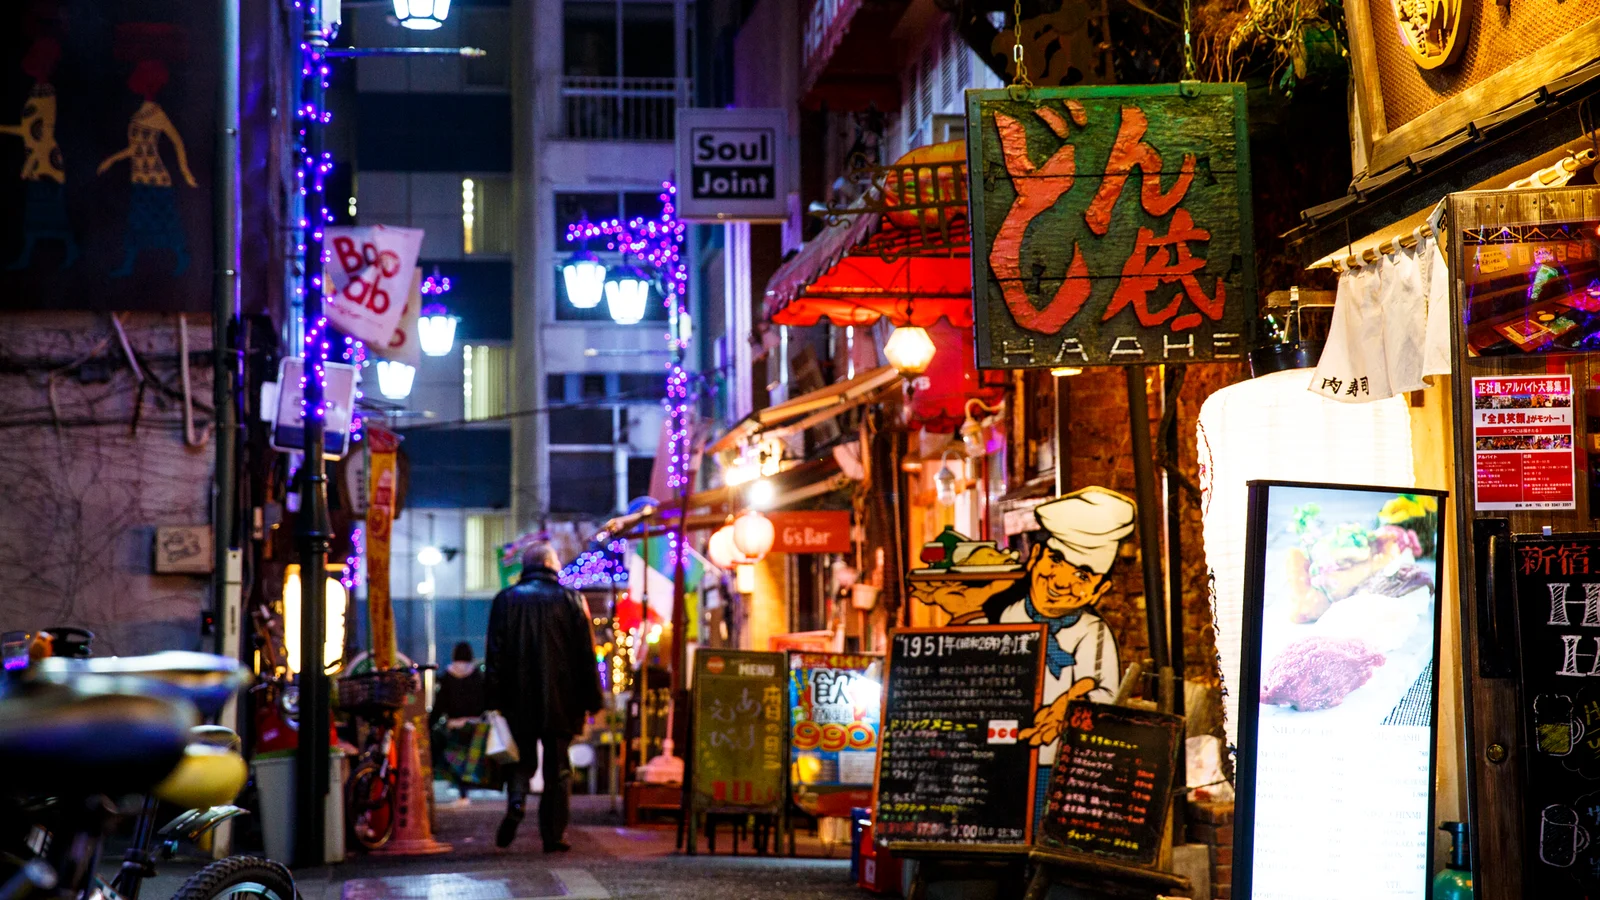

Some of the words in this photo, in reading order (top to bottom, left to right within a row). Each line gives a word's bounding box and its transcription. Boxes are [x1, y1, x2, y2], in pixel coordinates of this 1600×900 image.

[698, 133, 768, 160] Soul
[698, 170, 769, 194] Joint
[1321, 375, 1370, 397] 肉寿司
[804, 527, 831, 545] Bar
[1518, 543, 1600, 575] 新宿
[738, 664, 775, 676] MENU
[793, 721, 876, 751] 990
